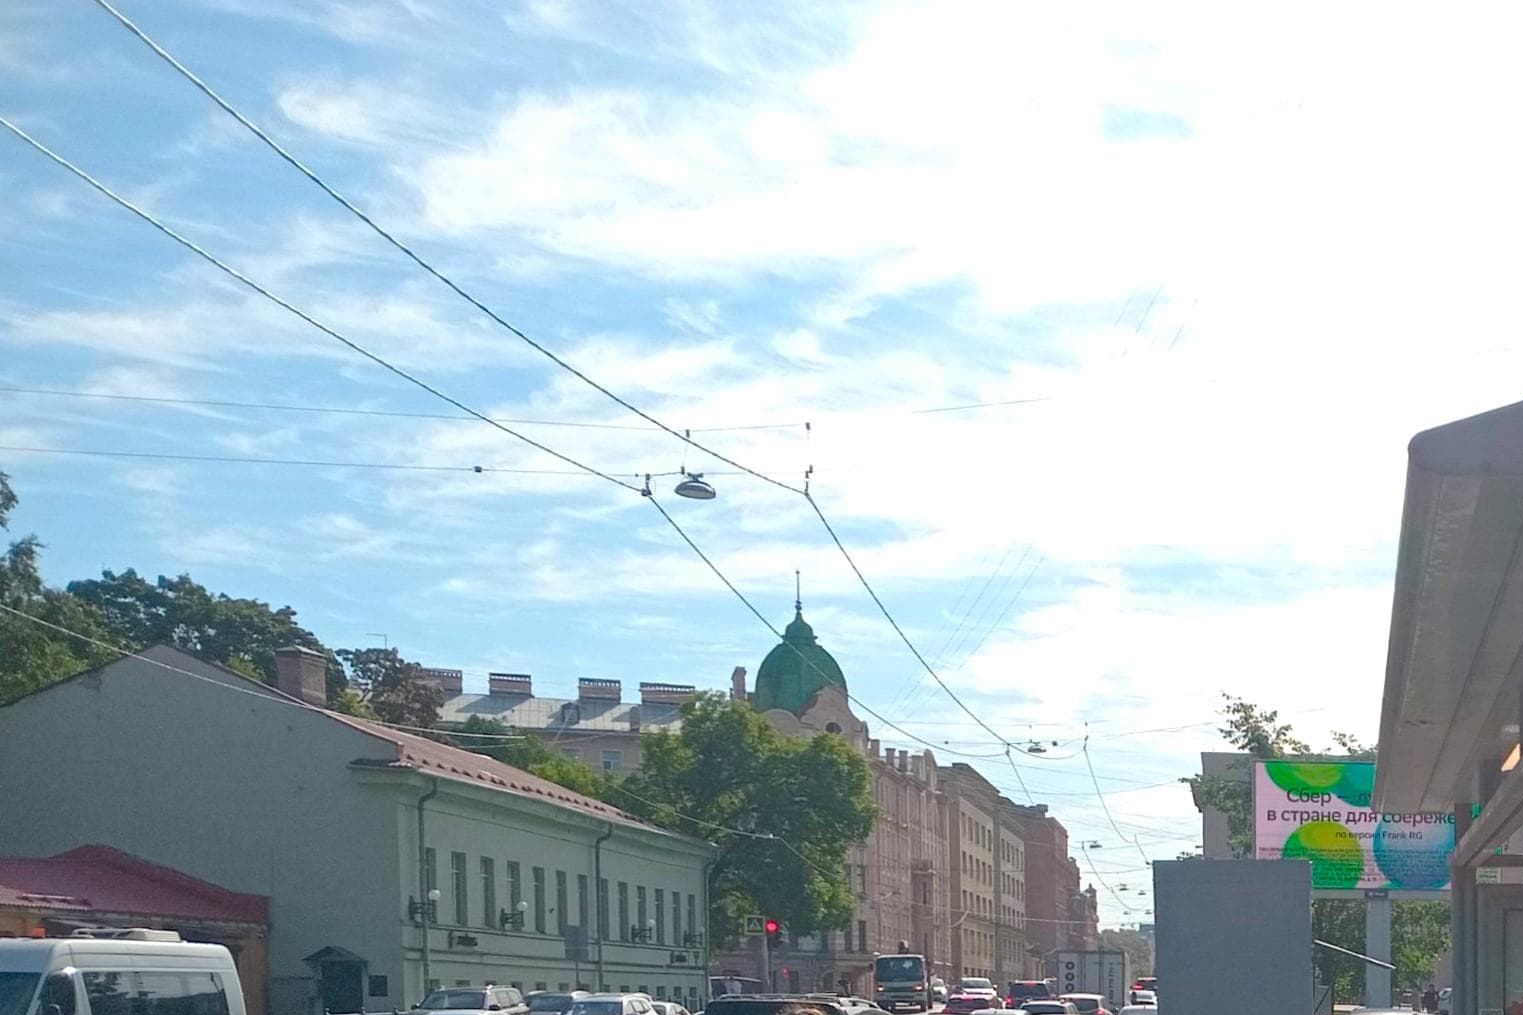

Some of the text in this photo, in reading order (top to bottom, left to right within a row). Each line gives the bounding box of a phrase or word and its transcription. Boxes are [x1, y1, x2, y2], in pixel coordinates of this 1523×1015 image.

[1286, 787, 1332, 806] Сбер
[1266, 810, 1277, 821] в
[1281, 810, 1341, 824] стране
[1345, 811, 1377, 825] для
[1382, 831, 1406, 840] Frank
[1409, 831, 1423, 840] RG
